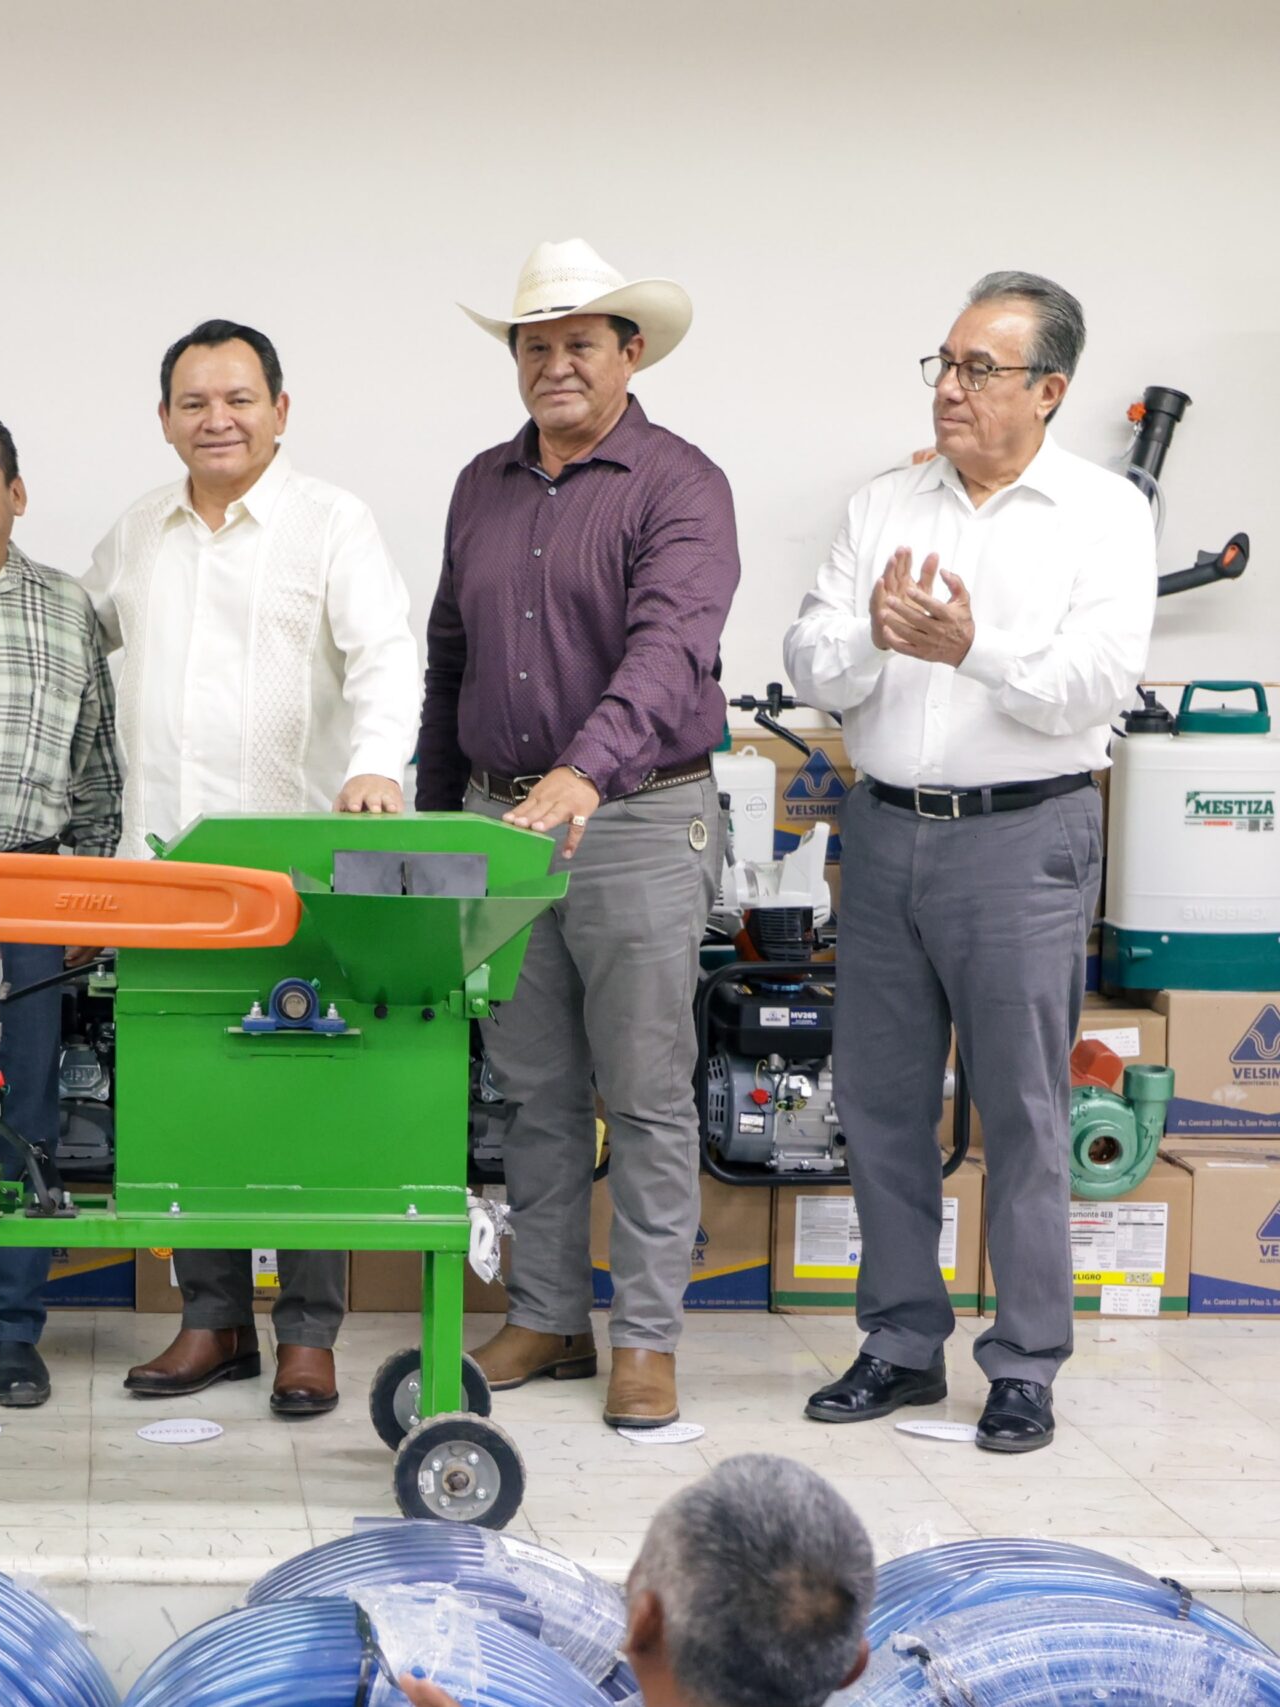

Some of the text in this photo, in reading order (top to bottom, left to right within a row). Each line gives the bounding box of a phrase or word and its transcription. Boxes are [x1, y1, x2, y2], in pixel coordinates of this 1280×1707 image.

[1194, 799, 1274, 815] MESTIZA
[54, 893, 118, 911] STIHL
[1232, 1067, 1280, 1079] VELSIM
